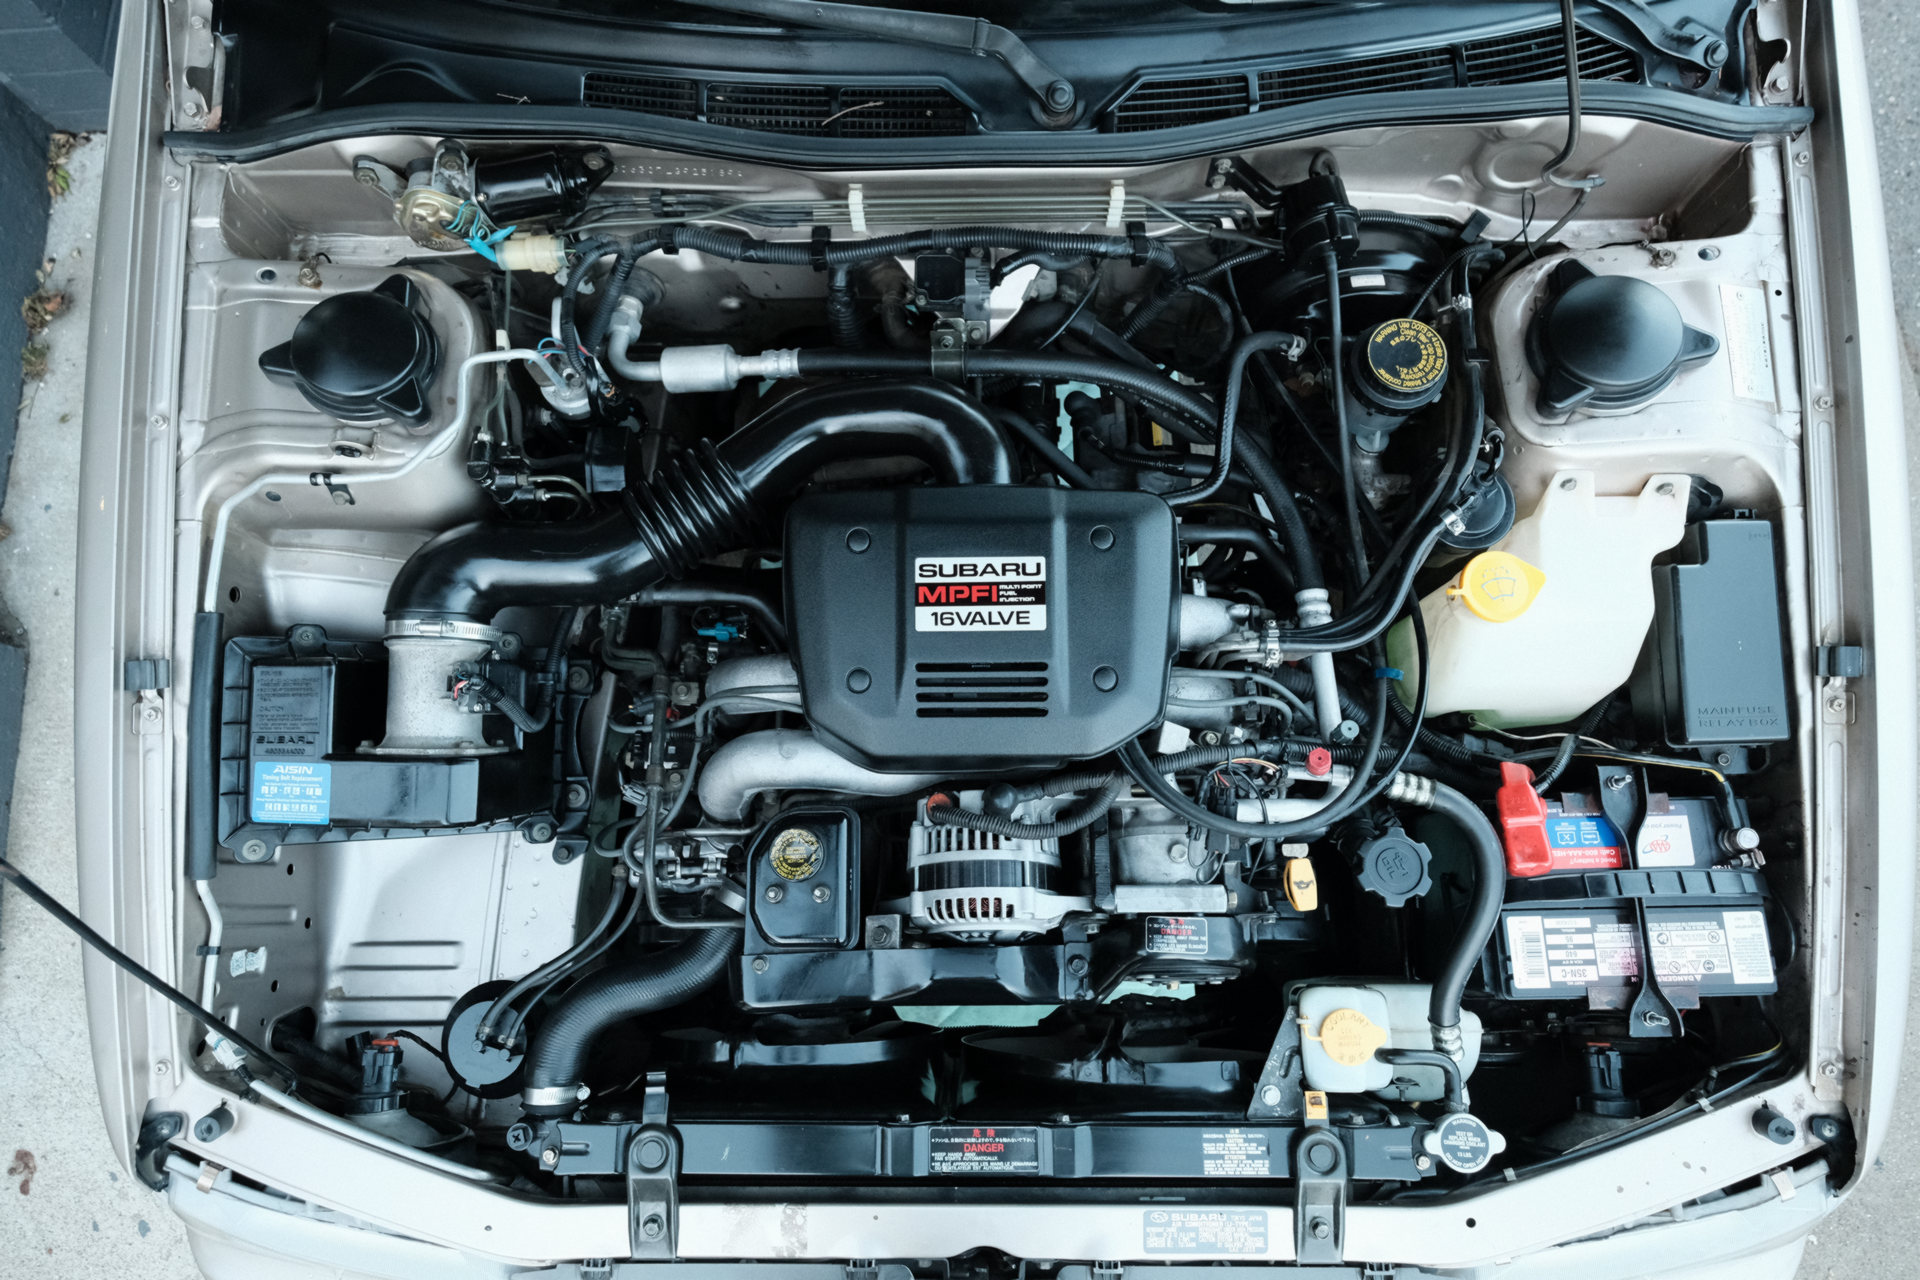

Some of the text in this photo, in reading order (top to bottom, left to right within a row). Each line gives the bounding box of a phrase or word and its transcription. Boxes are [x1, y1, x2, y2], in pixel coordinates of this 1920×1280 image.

[1375, 324, 1398, 343] WARNING
[918, 562, 1041, 578] SUBARU
[918, 585, 998, 604] MPFI
[930, 610, 1031, 626] 16VALVE
[273, 765, 313, 774] AISIN
[262, 774, 280, 782] Timing
[1652, 841, 1668, 852] AAA
[1382, 857, 1395, 879] OIL
[1160, 928, 1192, 936] DANGER
[1562, 968, 1587, 978] 35N-C
[964, 1144, 1004, 1152] DANGER
[1171, 1213, 1226, 1221] SUBARU
